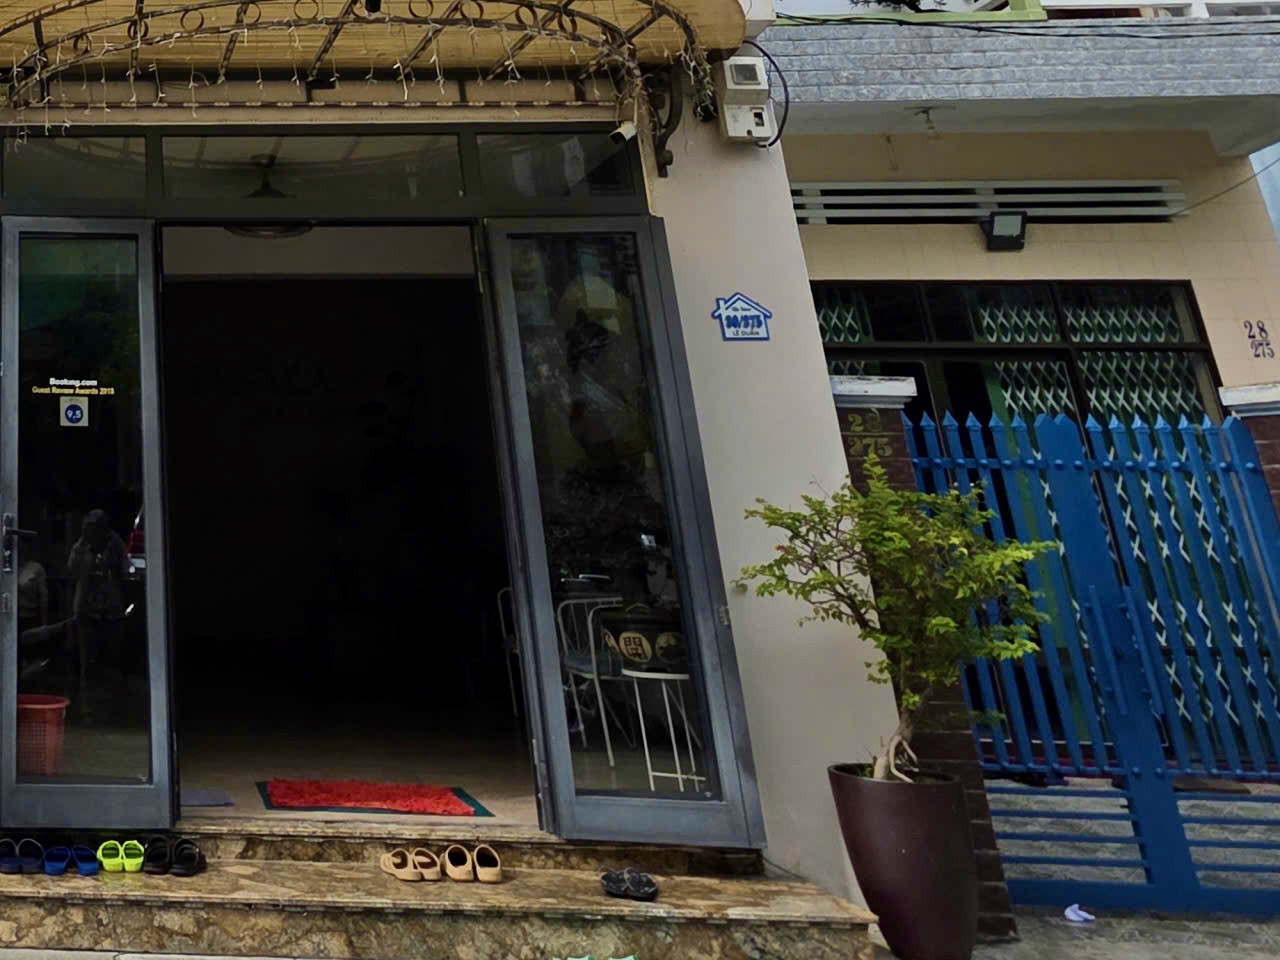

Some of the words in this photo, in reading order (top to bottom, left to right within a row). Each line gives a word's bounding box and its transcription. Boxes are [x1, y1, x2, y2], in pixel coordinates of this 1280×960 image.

[1243, 320, 1269, 339] 28
[1250, 340, 1275, 359] 275
[49, 377, 98, 387] Booking.com
[847, 436, 893, 457] 275
